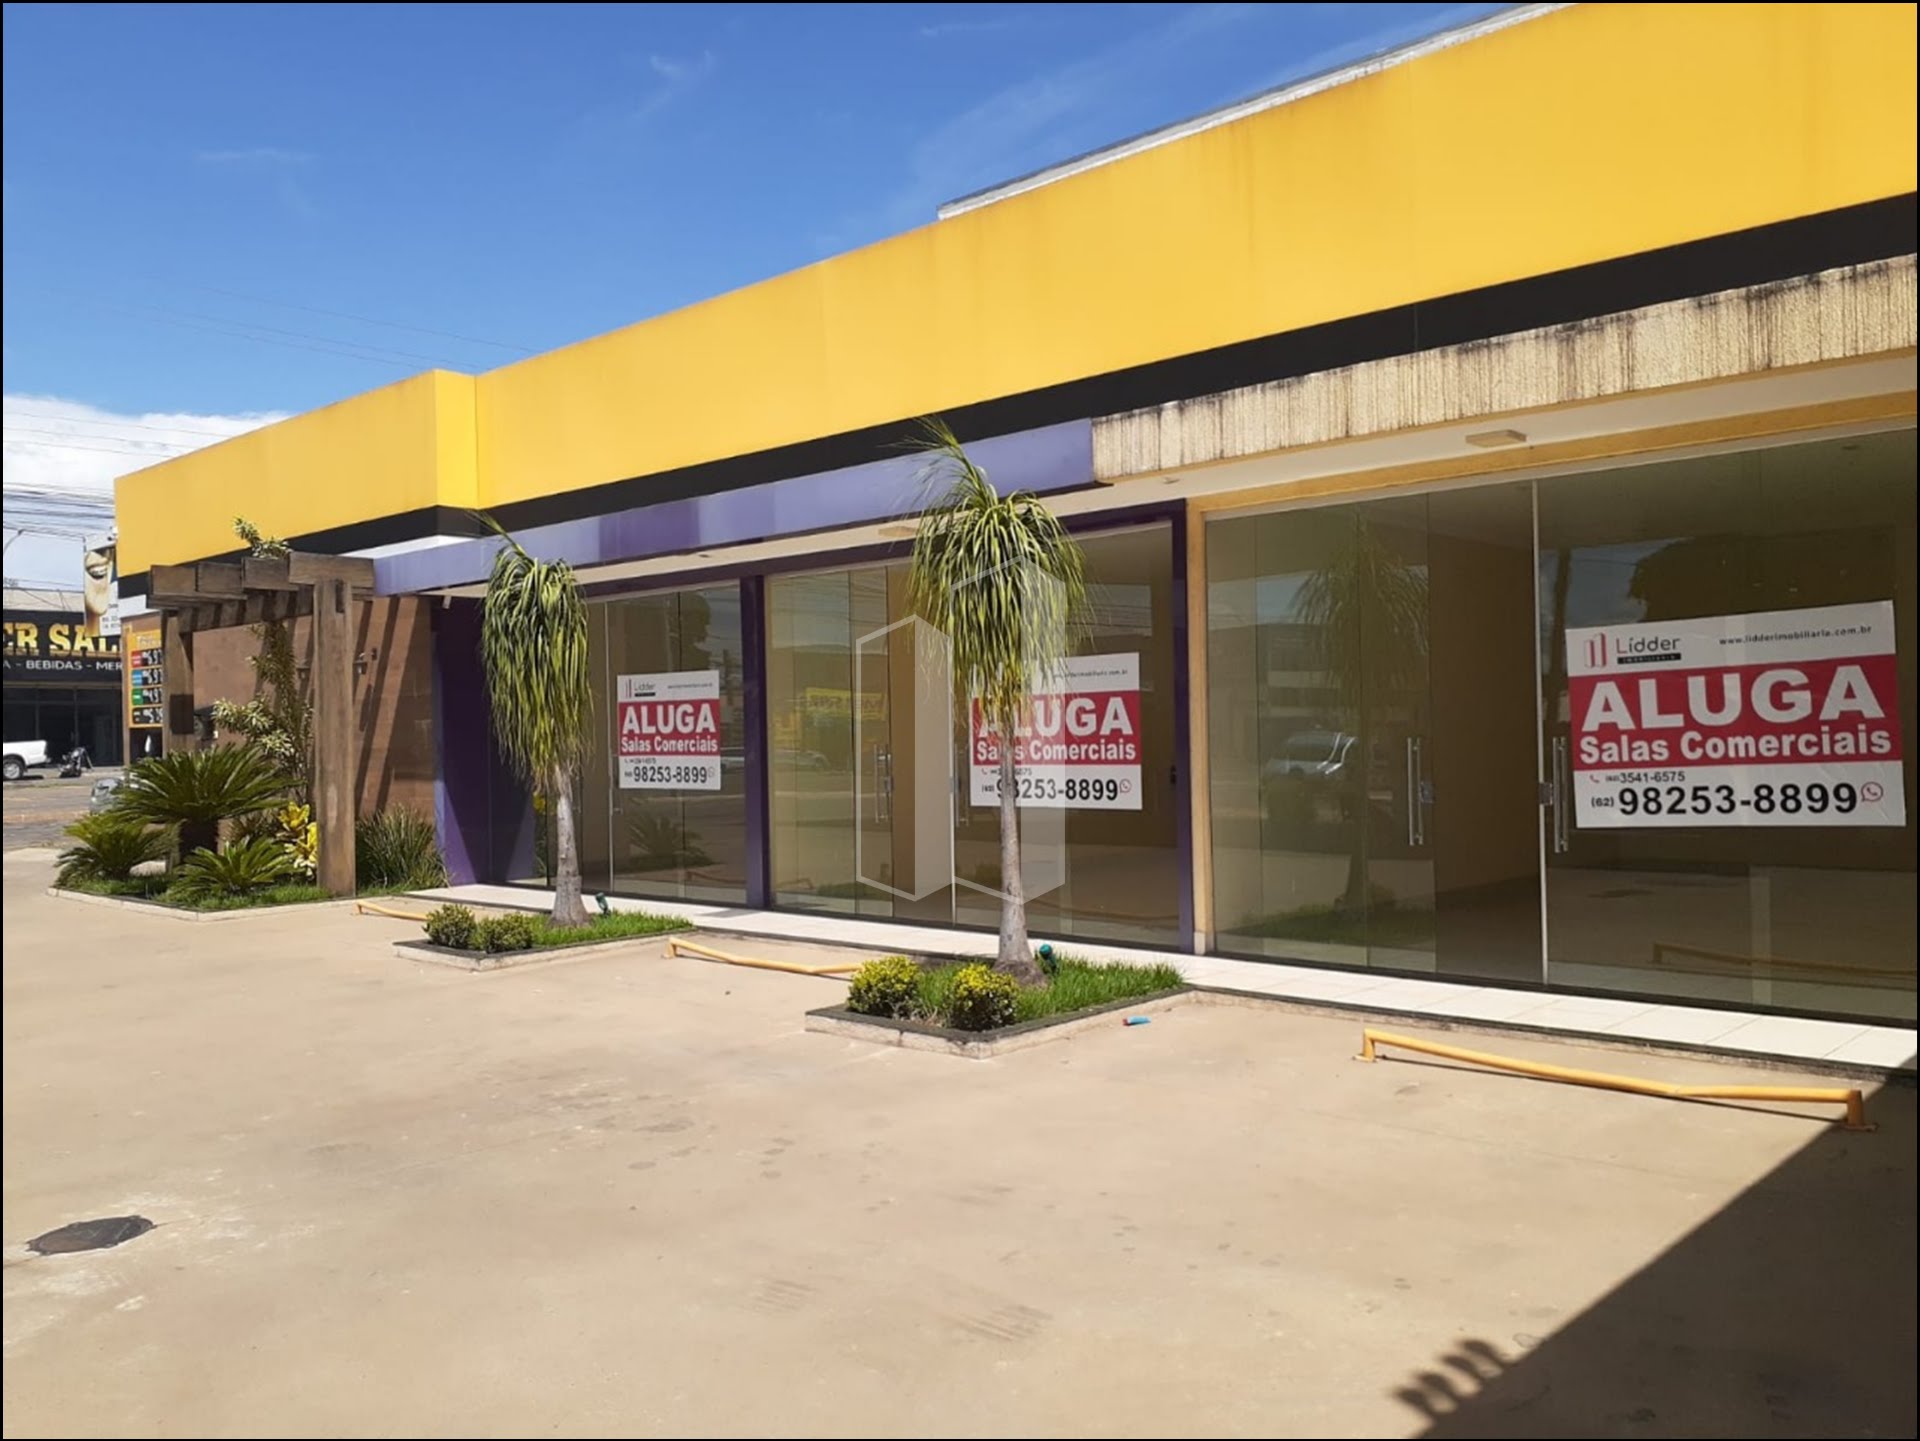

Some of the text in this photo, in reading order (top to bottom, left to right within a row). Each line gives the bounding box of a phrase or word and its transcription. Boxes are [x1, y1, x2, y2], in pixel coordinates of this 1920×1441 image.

[26, 660, 82, 670] BEBIDAS
[1581, 664, 1885, 732] ALUGA
[622, 703, 716, 734] ALUGA
[621, 736, 651, 752] Salas
[1030, 738, 1136, 761] Comerciais
[1580, 724, 1891, 765] Salas Comerciais
[1591, 782, 1858, 816] (62) 98253-8899
